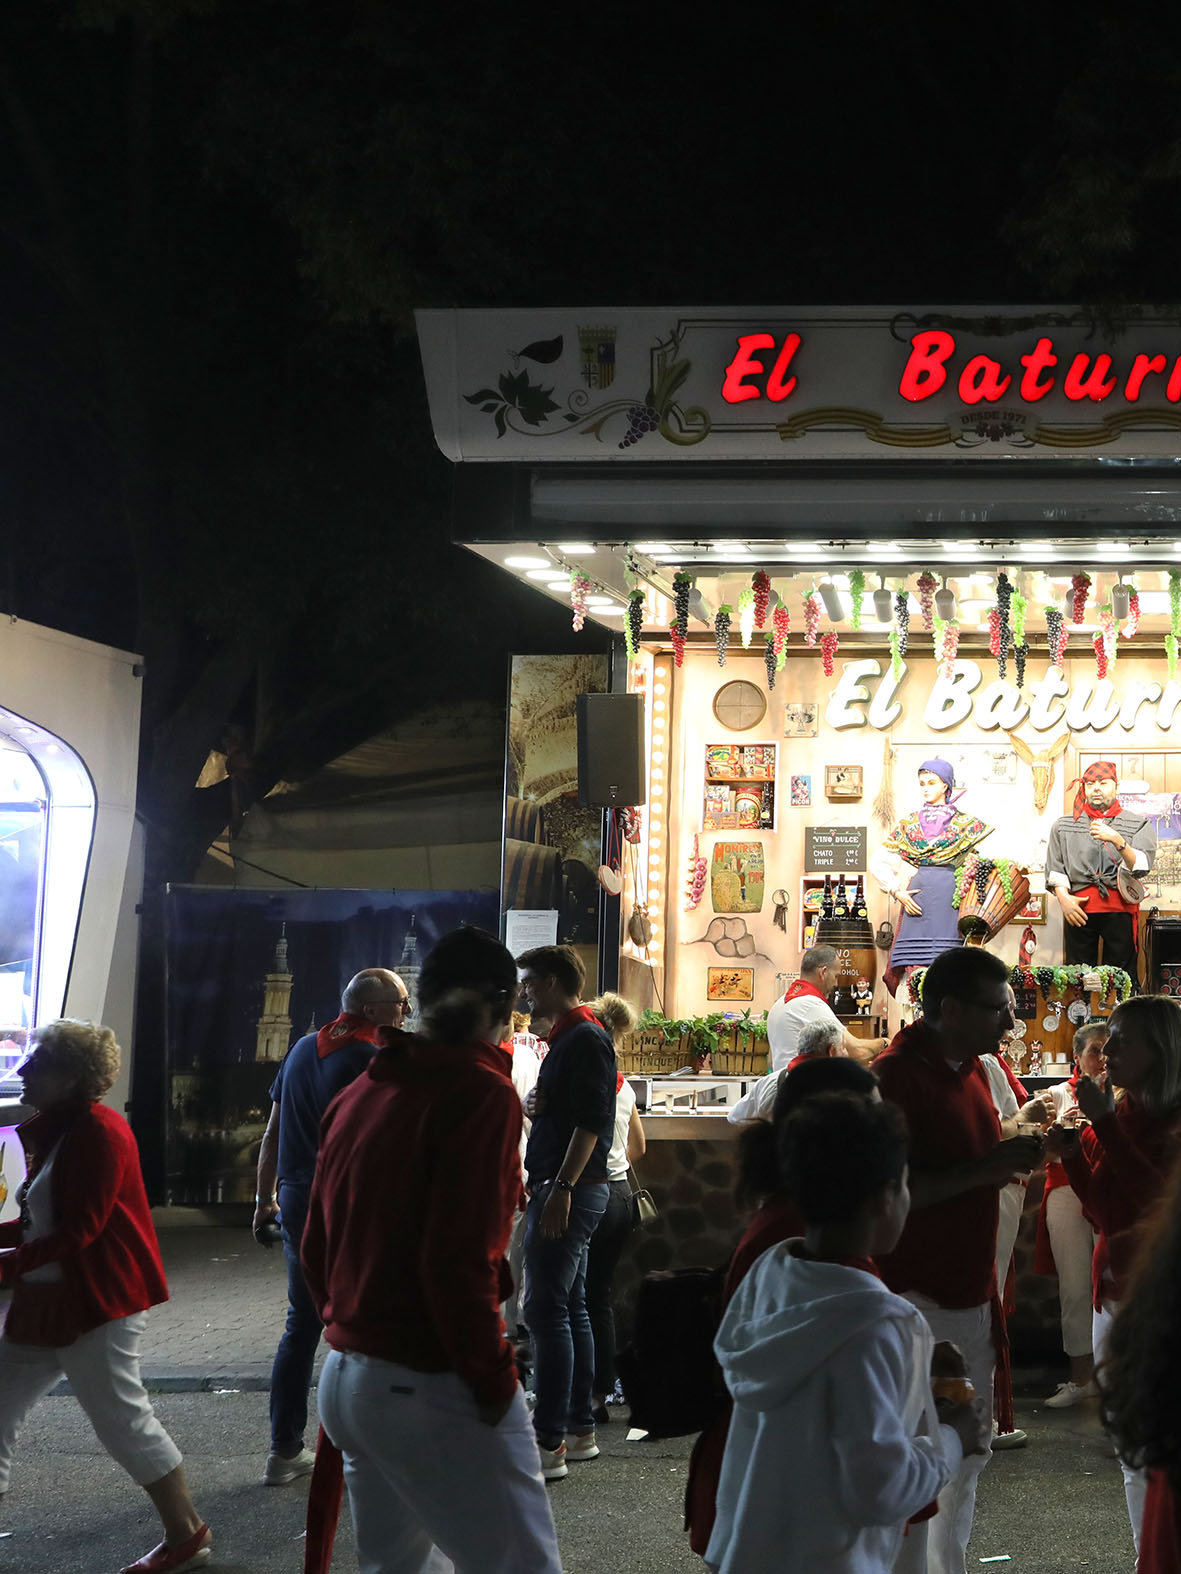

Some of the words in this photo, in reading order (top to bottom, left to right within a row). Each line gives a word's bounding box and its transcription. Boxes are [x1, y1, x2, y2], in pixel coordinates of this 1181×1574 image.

[721, 332, 801, 404] El
[960, 411, 1001, 425] DESDE
[824, 659, 909, 731] El
[813, 850, 834, 858] CHATO
[813, 858, 834, 866] TRIPLE
